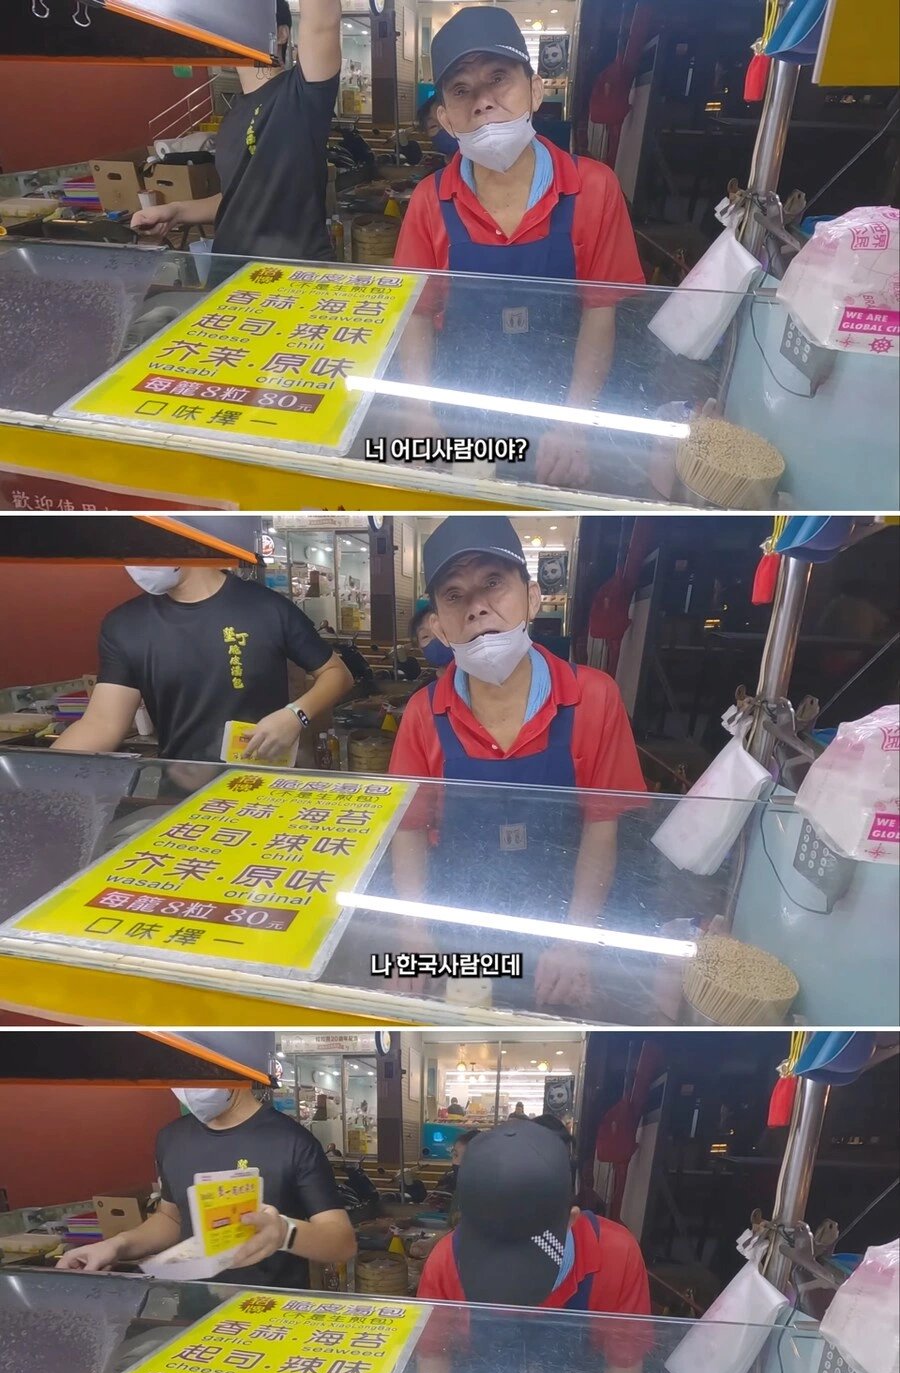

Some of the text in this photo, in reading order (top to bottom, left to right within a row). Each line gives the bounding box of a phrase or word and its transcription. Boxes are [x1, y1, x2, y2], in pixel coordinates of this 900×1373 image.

[216, 305, 385, 324] garlic seaweed
[846, 311, 888, 322] WE ARE
[842, 323, 882, 332] GLOBAL
[186, 330, 326, 350] cheese chili
[148, 362, 335, 390] wasabi original
[188, 814, 370, 834] garlic seaweed
[152, 841, 305, 862] cheese chili
[106, 874, 312, 905] wasabi original
[201, 1335, 386, 1357] garlic seaweed
